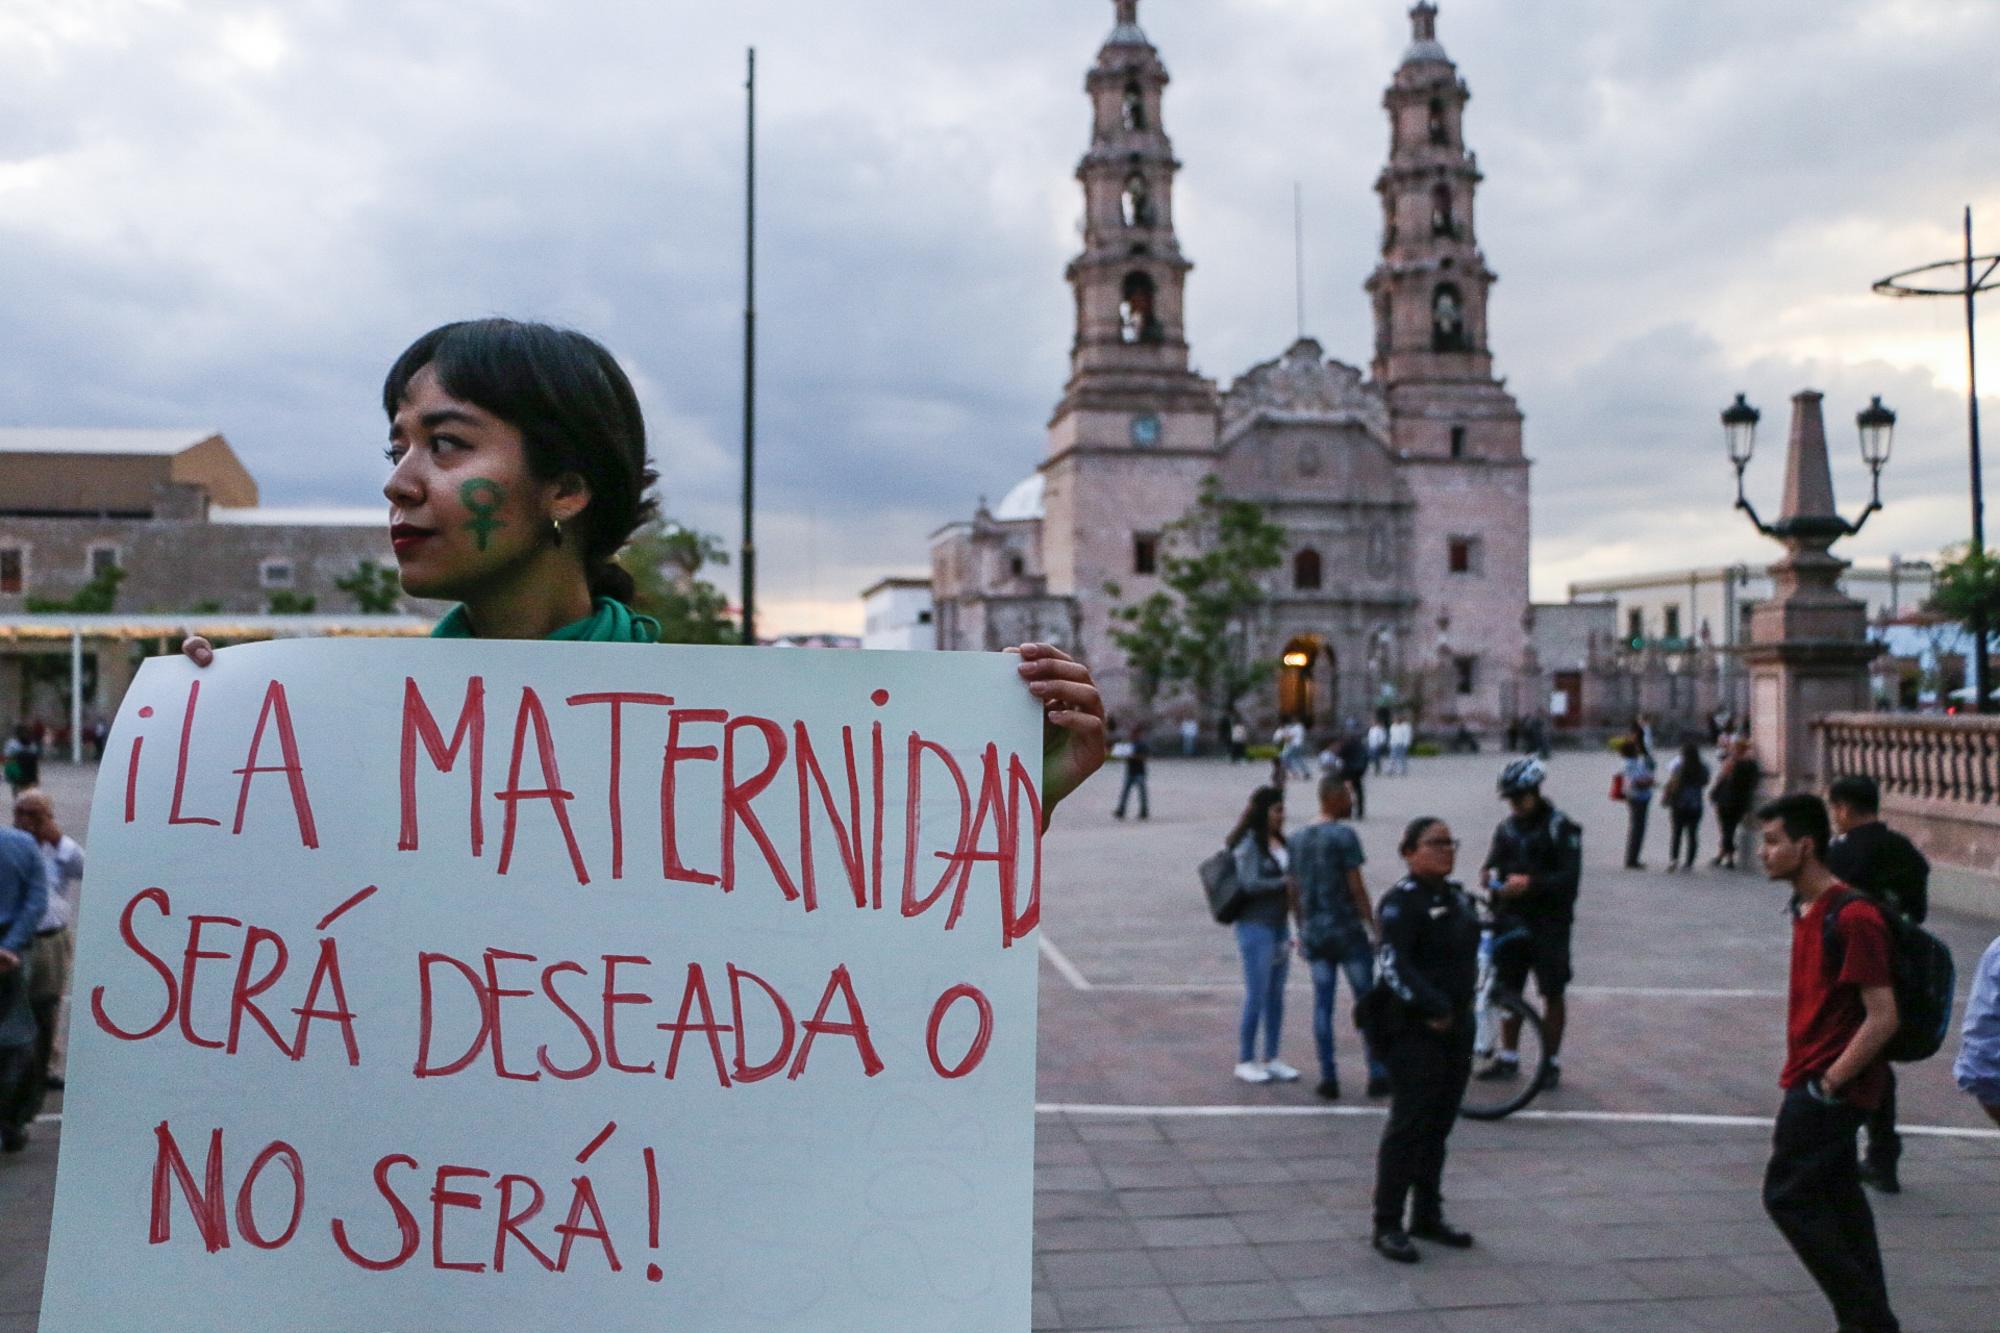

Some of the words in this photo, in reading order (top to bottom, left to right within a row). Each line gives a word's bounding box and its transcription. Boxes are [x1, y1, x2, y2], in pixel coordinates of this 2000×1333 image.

[90, 885, 377, 1067] SERÁ
[413, 948, 885, 1088] DESEADA
[926, 983, 994, 1079] O
[149, 1119, 305, 1253] NO
[331, 1122, 664, 1282] SERÁ!
